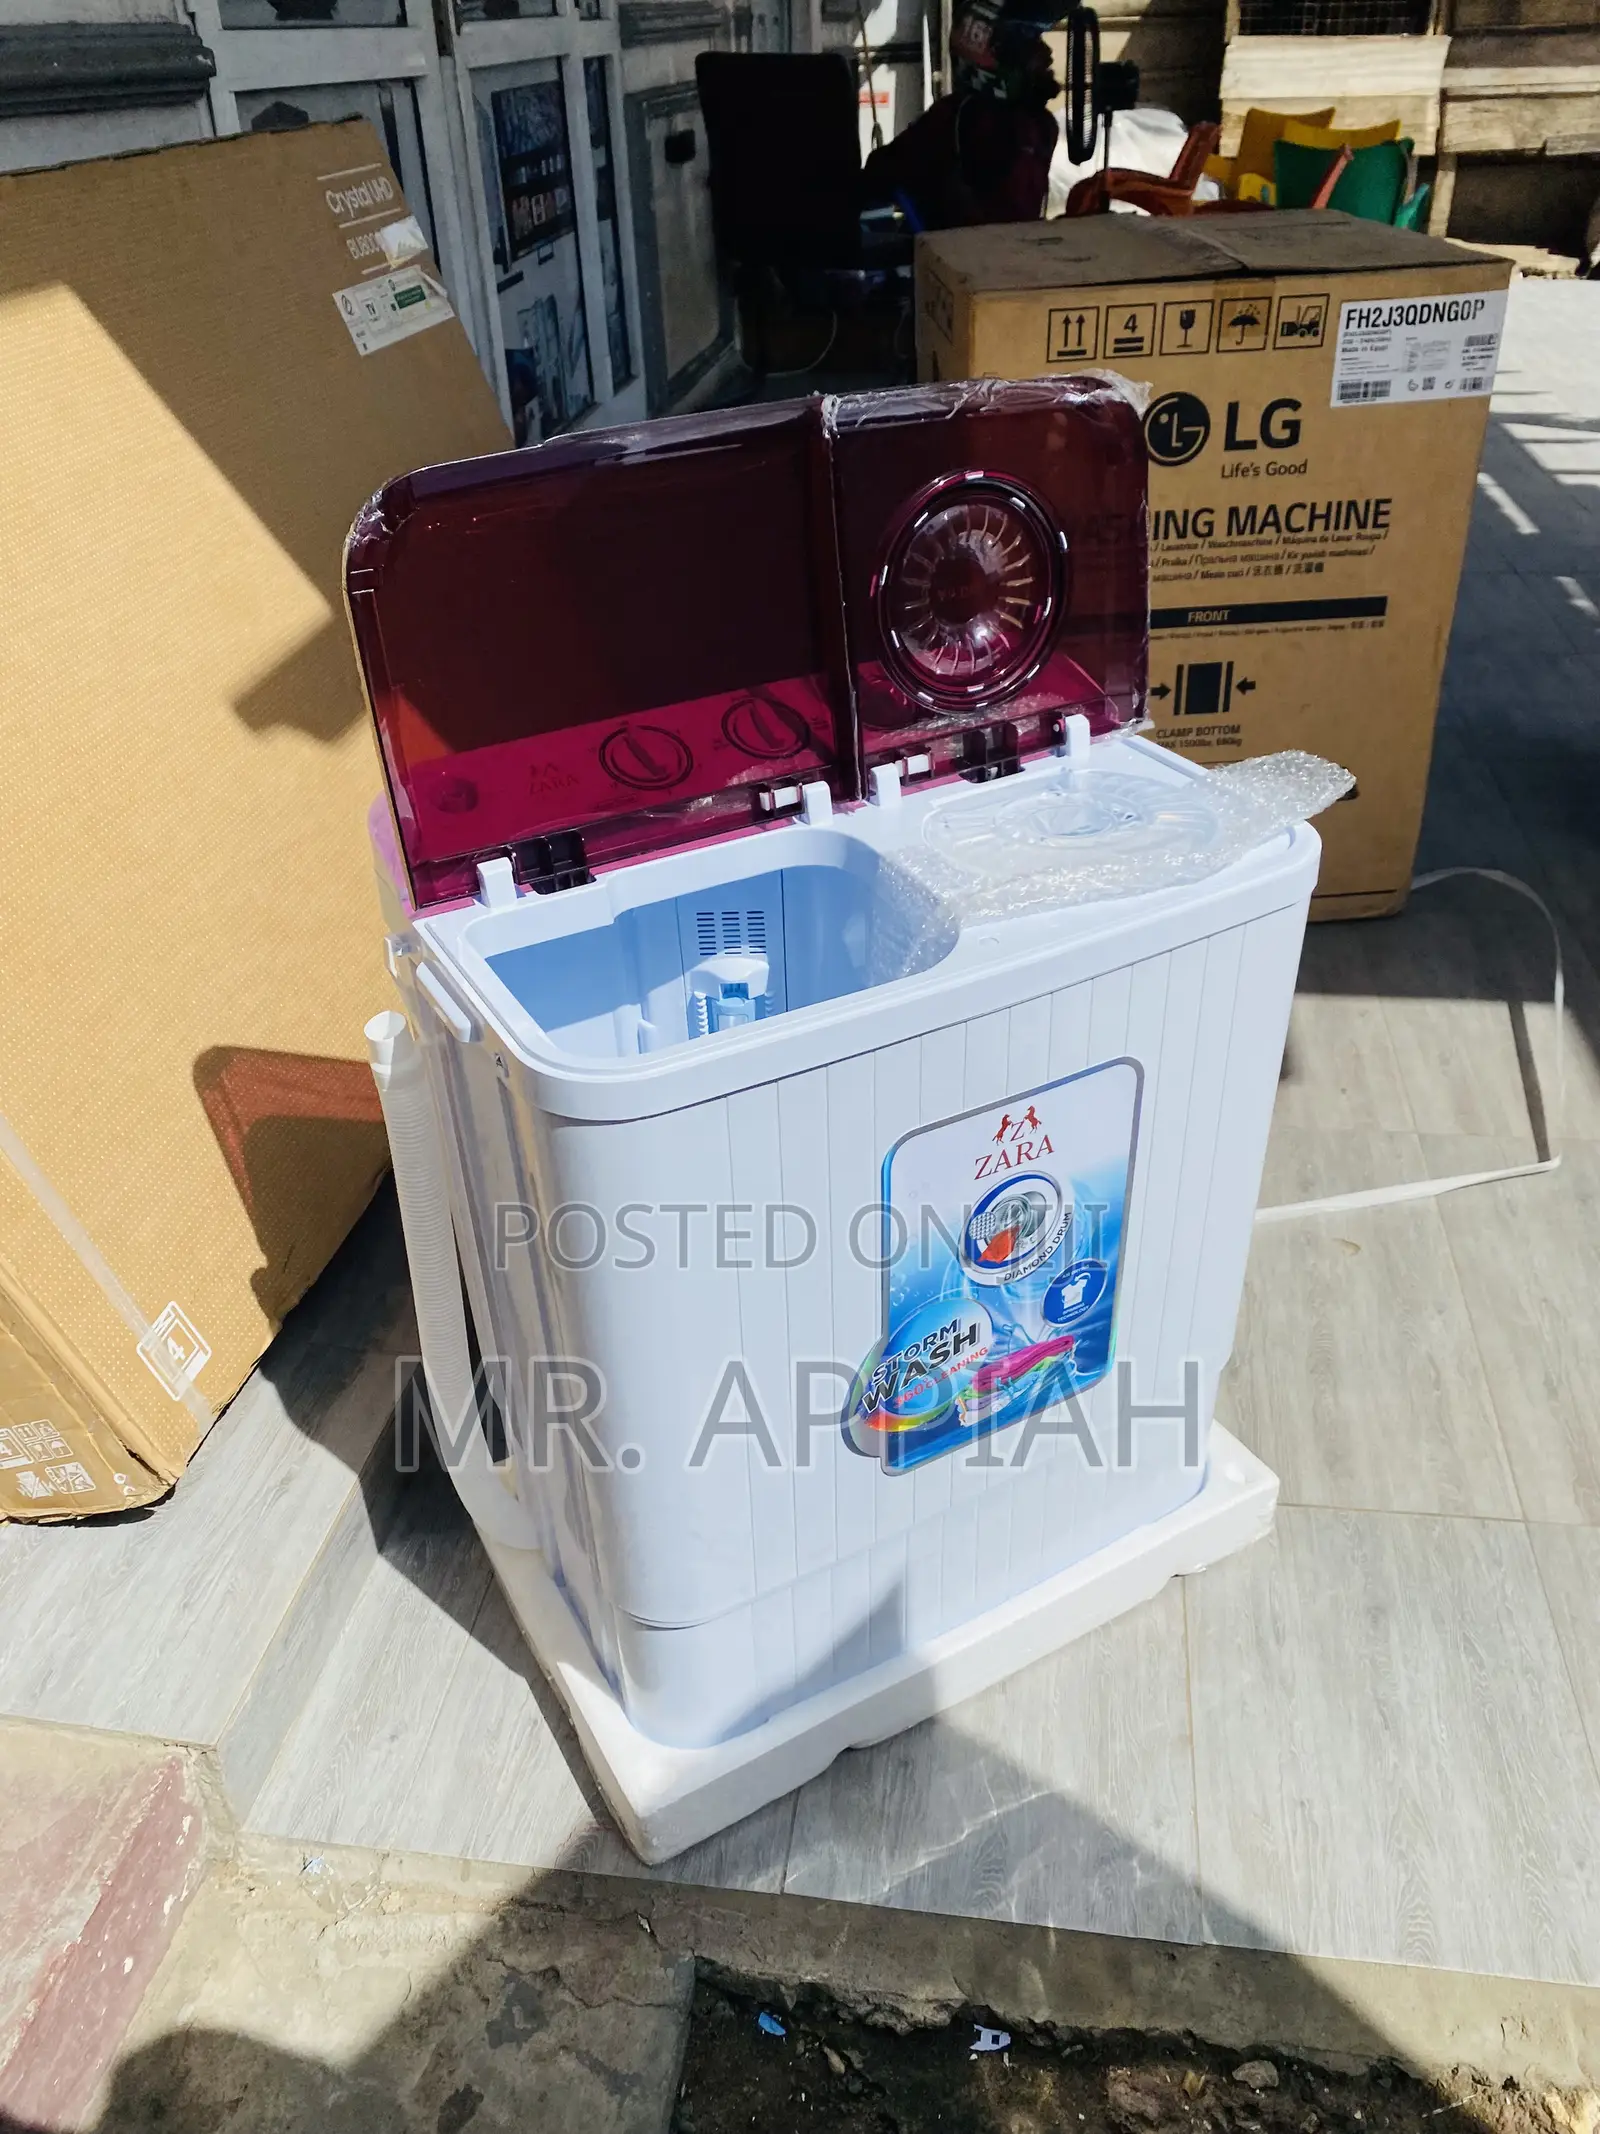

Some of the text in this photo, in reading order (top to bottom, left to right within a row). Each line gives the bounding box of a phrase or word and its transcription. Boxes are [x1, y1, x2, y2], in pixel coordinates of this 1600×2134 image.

[325, 176, 394, 218] Crystal UHD
[1223, 398, 1302, 451] LG
[1220, 458, 1309, 479] Life's Good
[1226, 498, 1393, 537] MACHINE
[1187, 609, 1231, 624] FRONT
[1156, 724, 1241, 739] CLAMP BOTTOM
[973, 1134, 1055, 1180] ZARA
[1003, 1245, 1053, 1281] DIAMOND
[1053, 1212, 1072, 1246] DRUM
[862, 1322, 978, 1413] WASH
[872, 1318, 959, 1384] STORM
